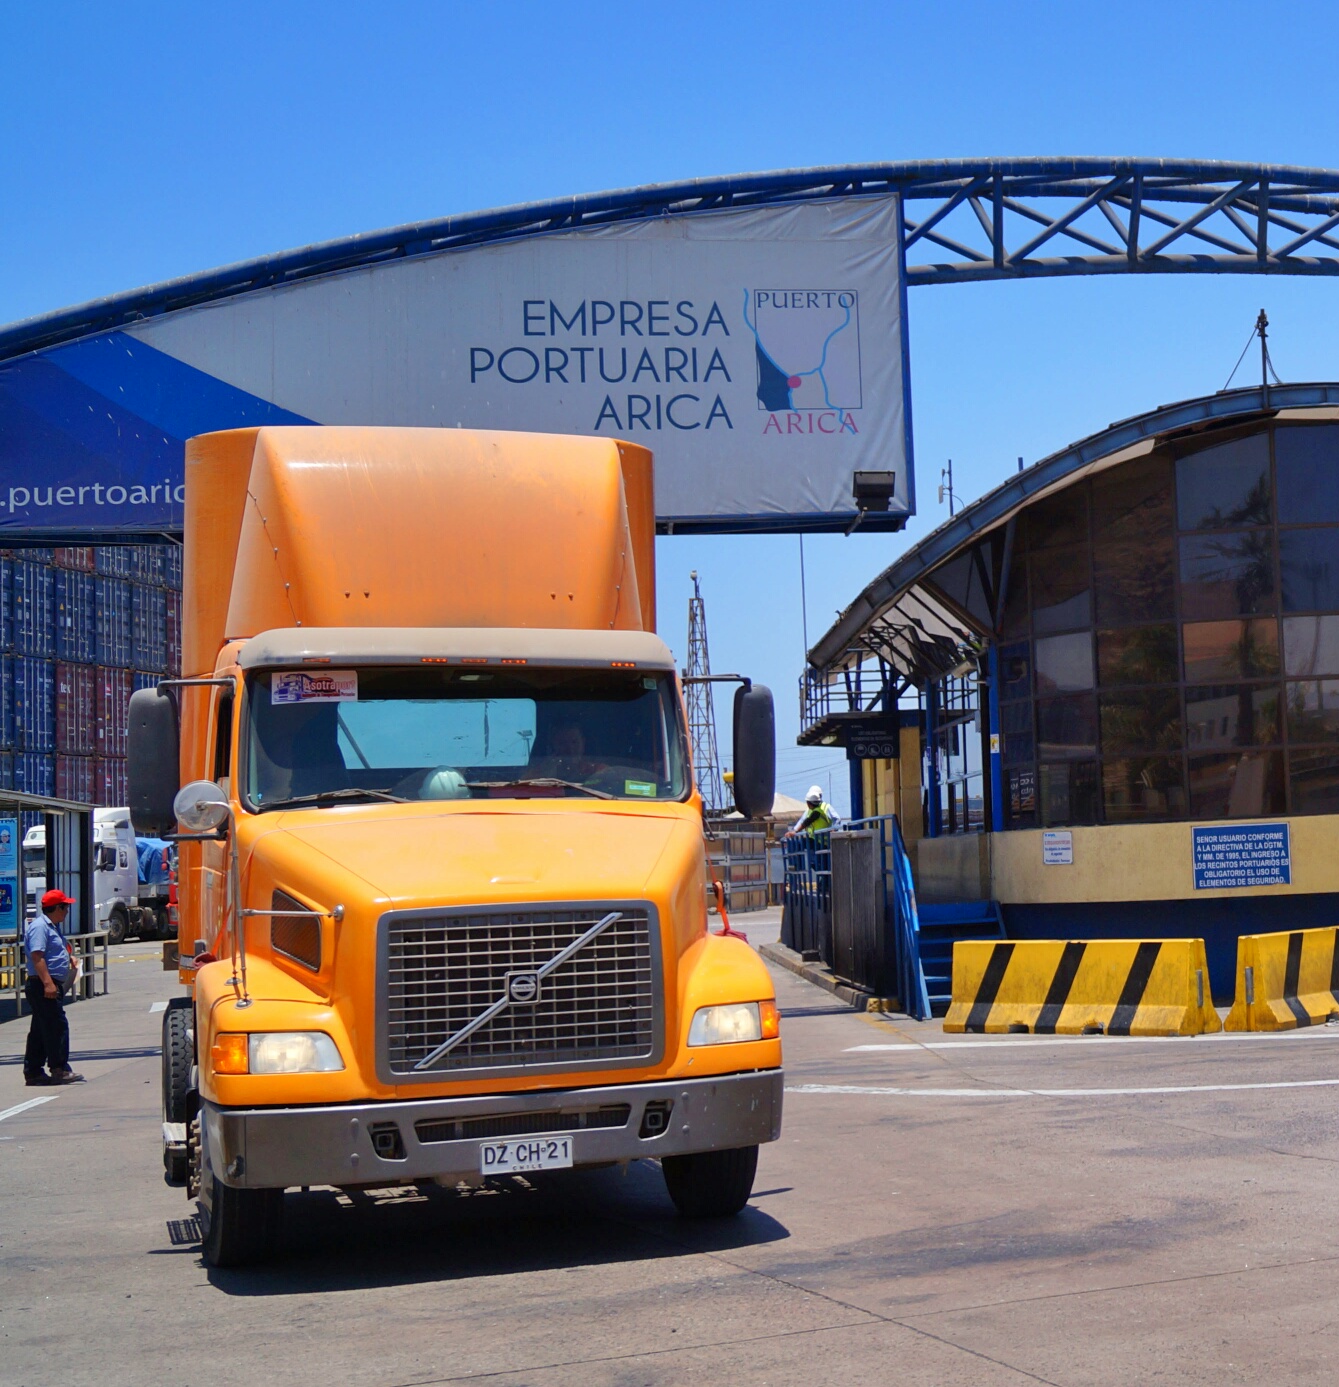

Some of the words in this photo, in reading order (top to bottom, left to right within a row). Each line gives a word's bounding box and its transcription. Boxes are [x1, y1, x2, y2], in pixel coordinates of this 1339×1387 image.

[757, 291, 856, 309] PUERTO
[523, 299, 731, 337] EMPRESA
[470, 346, 732, 384] PORTUARIA
[594, 393, 734, 431] ARICA
[762, 412, 860, 435] ARICA
[1218, 833, 1247, 842] USUARIO
[1247, 832, 1284, 841] CONFORME
[1211, 843, 1243, 851] DIRECTIVA
[1244, 842, 1253, 850] DE
[1242, 851, 1250, 859] EL
[1251, 850, 1279, 858] INGRESO
[1194, 862, 1206, 870] LOS
[1207, 860, 1238, 869] RECINTOS
[1240, 859, 1279, 868] PORTUARIOS
[1281, 858, 1289, 866] ES
[1203, 869, 1246, 878] OBLIGATORIO
[1247, 868, 1255, 876] EL
[1256, 868, 1270, 876] USO
[1271, 867, 1280, 875] DE
[1199, 879, 1236, 887] ELEMENTOS
